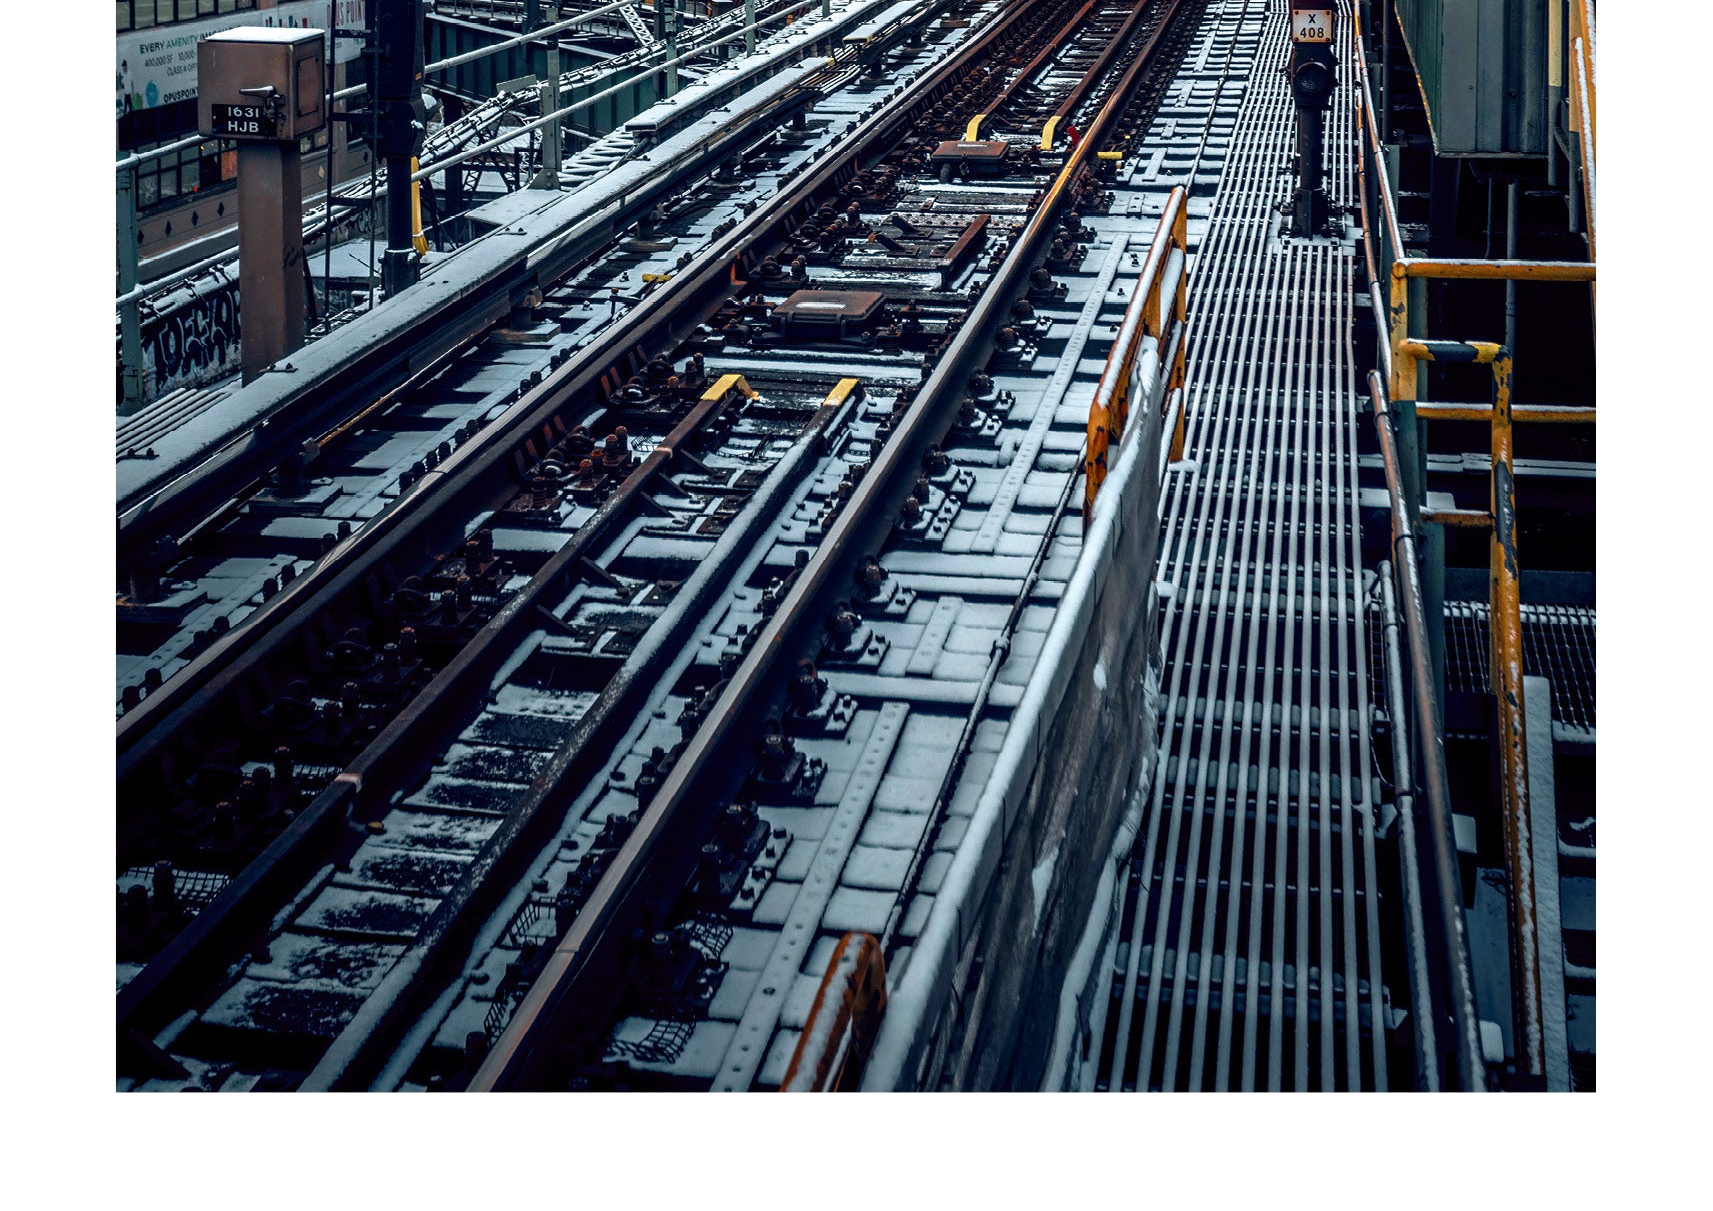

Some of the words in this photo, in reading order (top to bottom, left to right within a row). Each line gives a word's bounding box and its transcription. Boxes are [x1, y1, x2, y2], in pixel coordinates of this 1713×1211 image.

[326, 1, 345, 28] OUS
[1308, 13, 1317, 24] X
[1300, 27, 1325, 39] 408
[140, 40, 165, 54] EVERY
[166, 34, 198, 49] AMENITY
[228, 106, 259, 118] 1631
[228, 121, 259, 133] HJB
